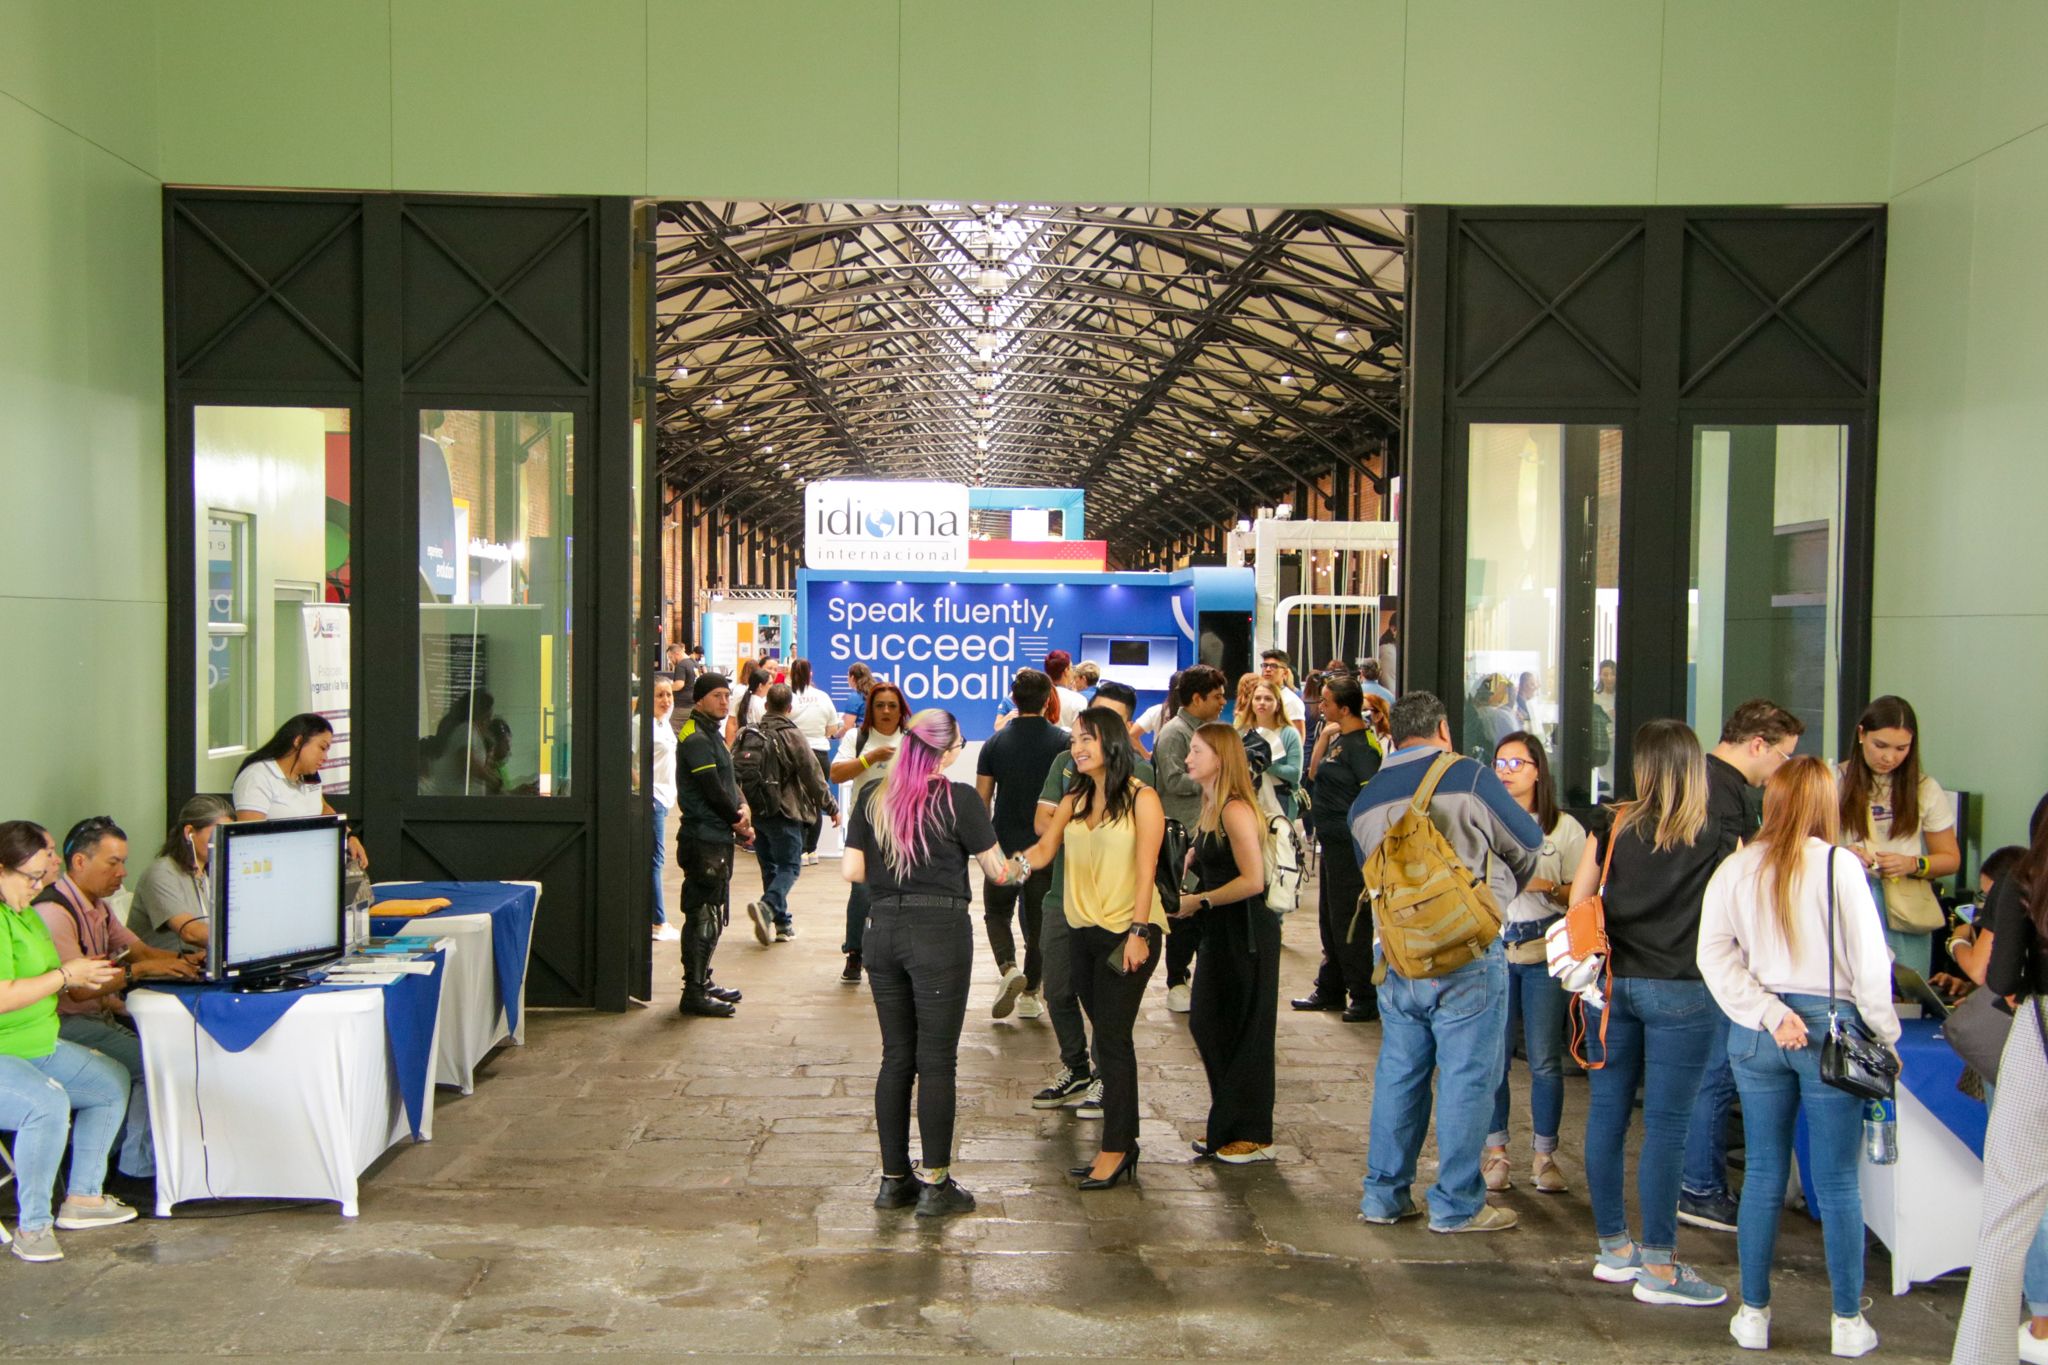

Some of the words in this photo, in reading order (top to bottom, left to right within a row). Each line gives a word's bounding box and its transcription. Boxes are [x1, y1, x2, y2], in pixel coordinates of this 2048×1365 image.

[818, 497, 960, 538] idioma
[818, 547, 958, 561] internacional
[828, 597, 925, 630] Speak
[932, 597, 1055, 632] fluently,
[830, 627, 1015, 662] succeed
[876, 664, 1018, 700] loball
